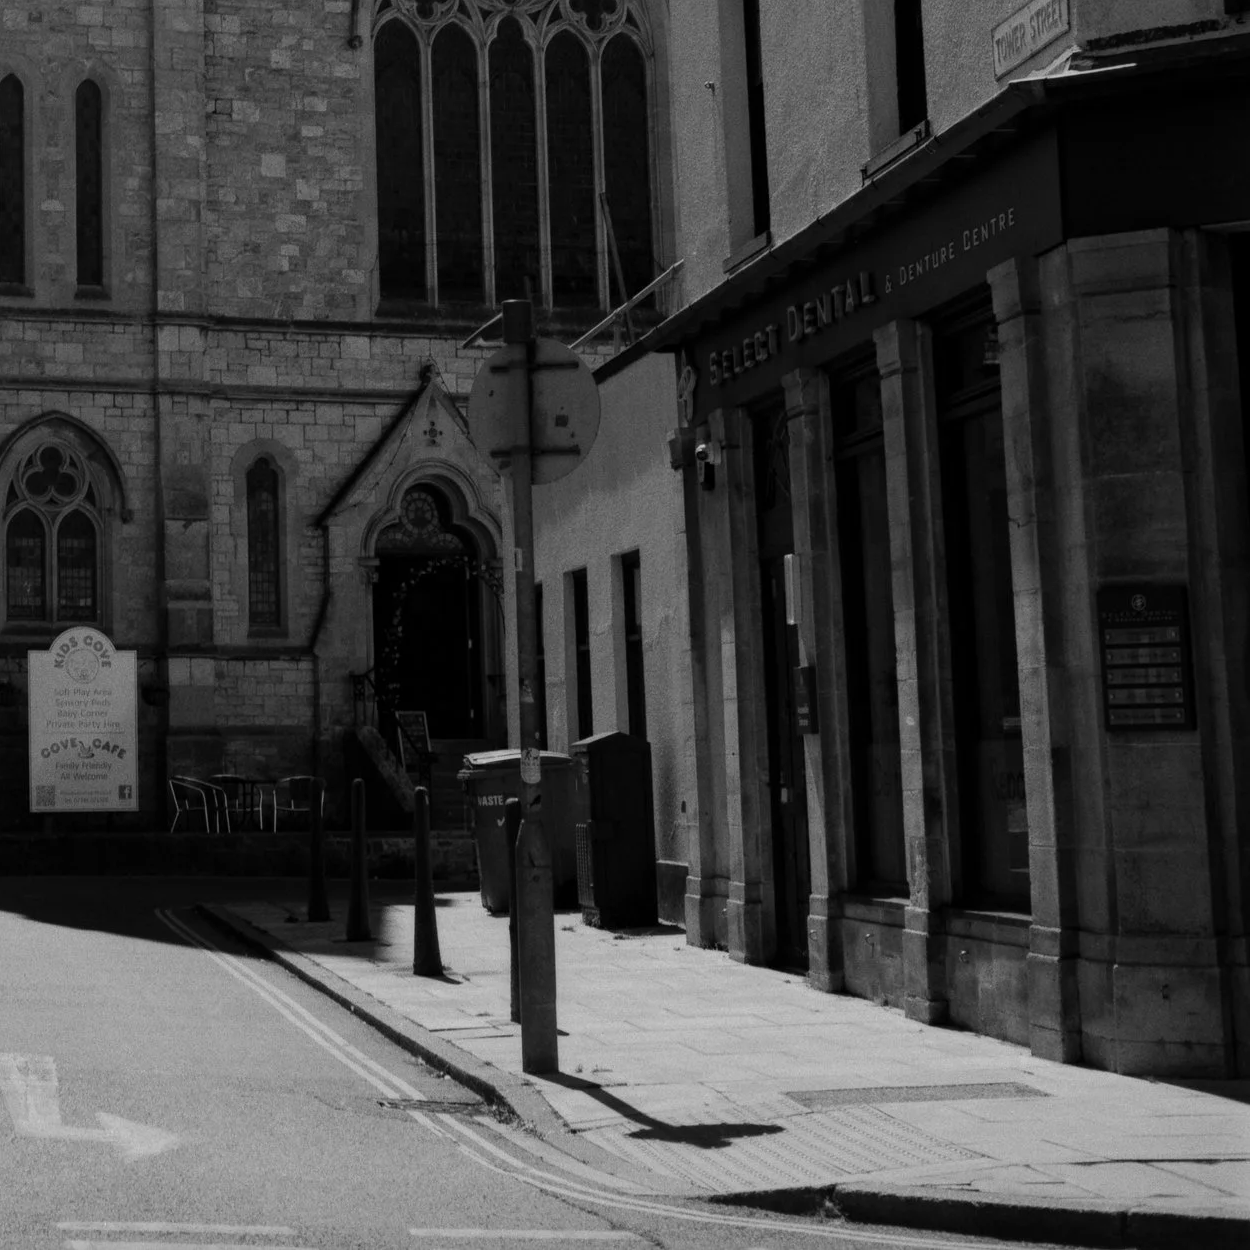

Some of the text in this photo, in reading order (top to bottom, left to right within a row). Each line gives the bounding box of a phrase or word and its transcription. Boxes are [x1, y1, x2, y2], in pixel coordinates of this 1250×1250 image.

[995, 22, 1027, 66] TOWER
[709, 207, 1016, 386] SELECT DENTAL & DENTURE CENTRE
[54, 635, 111, 669] KIDS COVE
[73, 688, 90, 697] Play
[80, 709, 108, 717] Corner
[46, 720, 75, 728] Private
[78, 720, 101, 729] Party
[41, 738, 127, 760] COVE CAFE
[55, 762, 113, 771] Family Friendly
[60, 772, 108, 781] All Welcome
